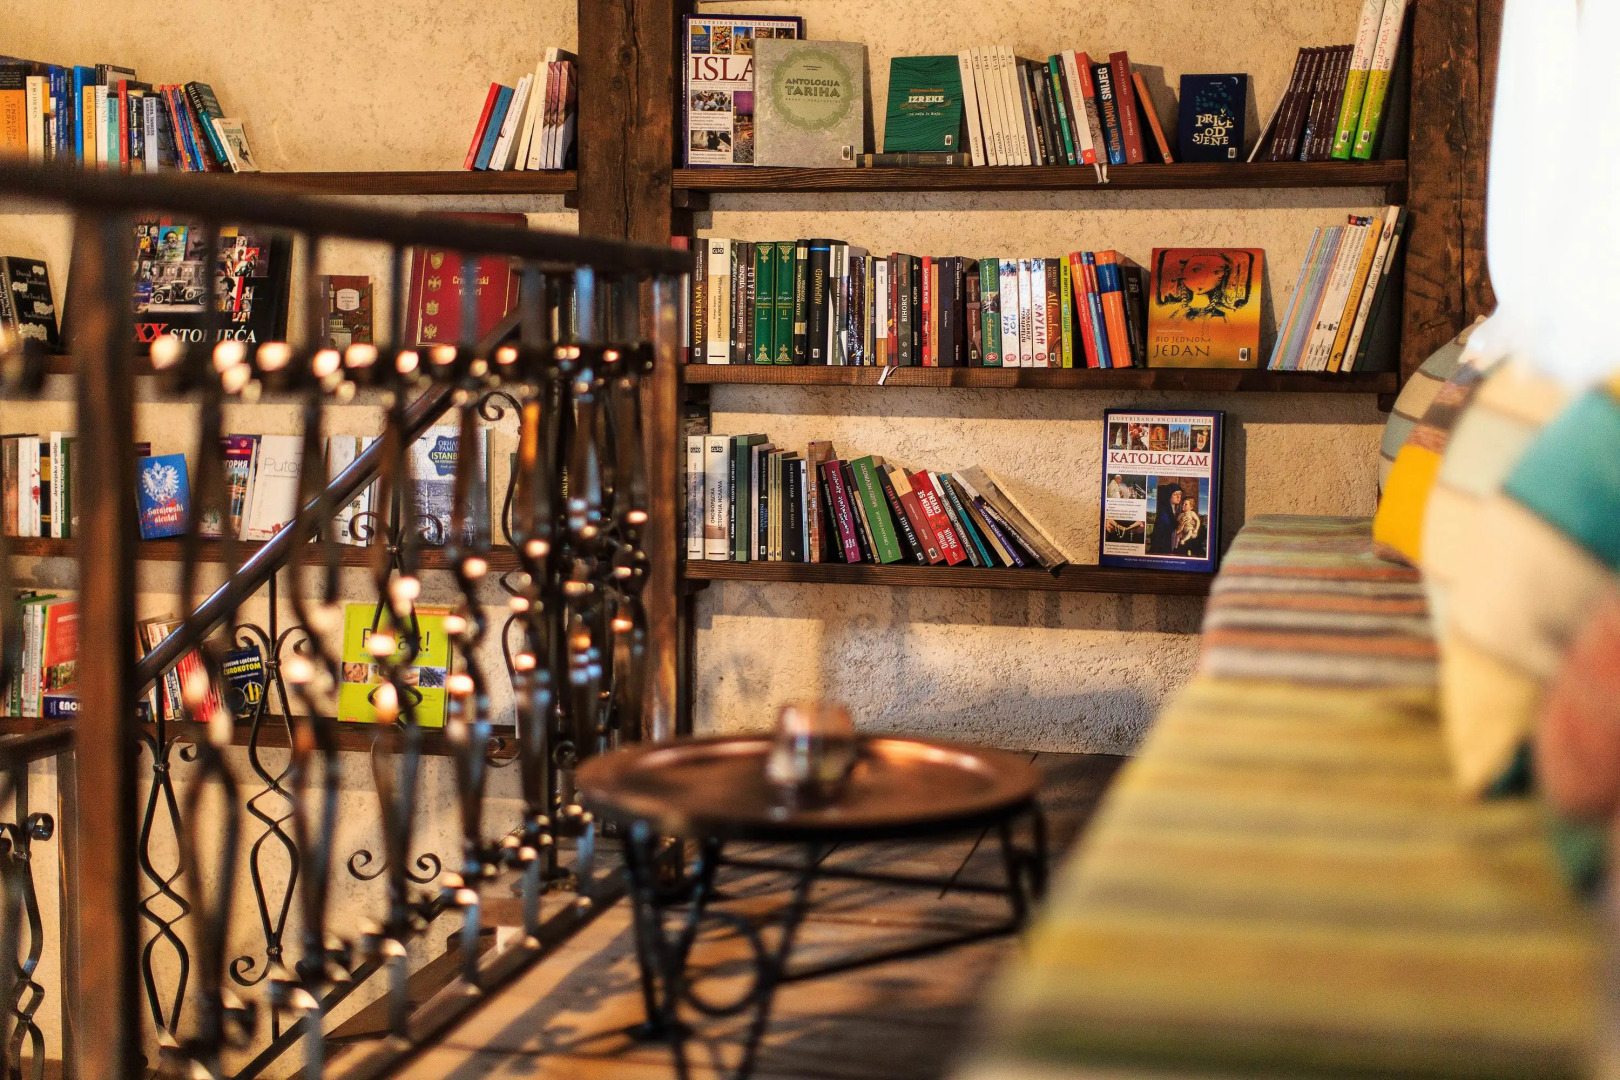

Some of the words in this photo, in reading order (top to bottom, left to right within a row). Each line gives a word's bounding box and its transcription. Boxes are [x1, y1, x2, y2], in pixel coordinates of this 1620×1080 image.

[785, 86, 840, 97] TARIHA
[786, 78, 840, 86] ANTOLOGIJA
[1098, 67, 1112, 99] SNIJEG
[188, 85, 204, 113] MILLER'S
[908, 95, 944, 103] IZREKE
[1105, 100, 1117, 127] PAMUK
[1111, 128, 1121, 151] Orhan
[1192, 133, 1229, 146] SJENE
[1205, 126, 1226, 137] OD
[814, 268, 822, 305] MUHAMMED
[1034, 303, 1045, 345] RAYLAN
[1046, 290, 1060, 340] Alhambra
[132, 322, 169, 343] XX
[169, 325, 257, 343] STOJEĆA
[986, 317, 995, 348] Skandal
[1153, 345, 1210, 357] JEDAN
[1110, 452, 1208, 466] KATOLICIZAM
[920, 497, 935, 518] ZOVEM
[926, 490, 942, 515] CRVENA
[936, 531, 949, 549] Orhan
[943, 527, 958, 549] PAMUK
[58, 701, 82, 712] ENCI
